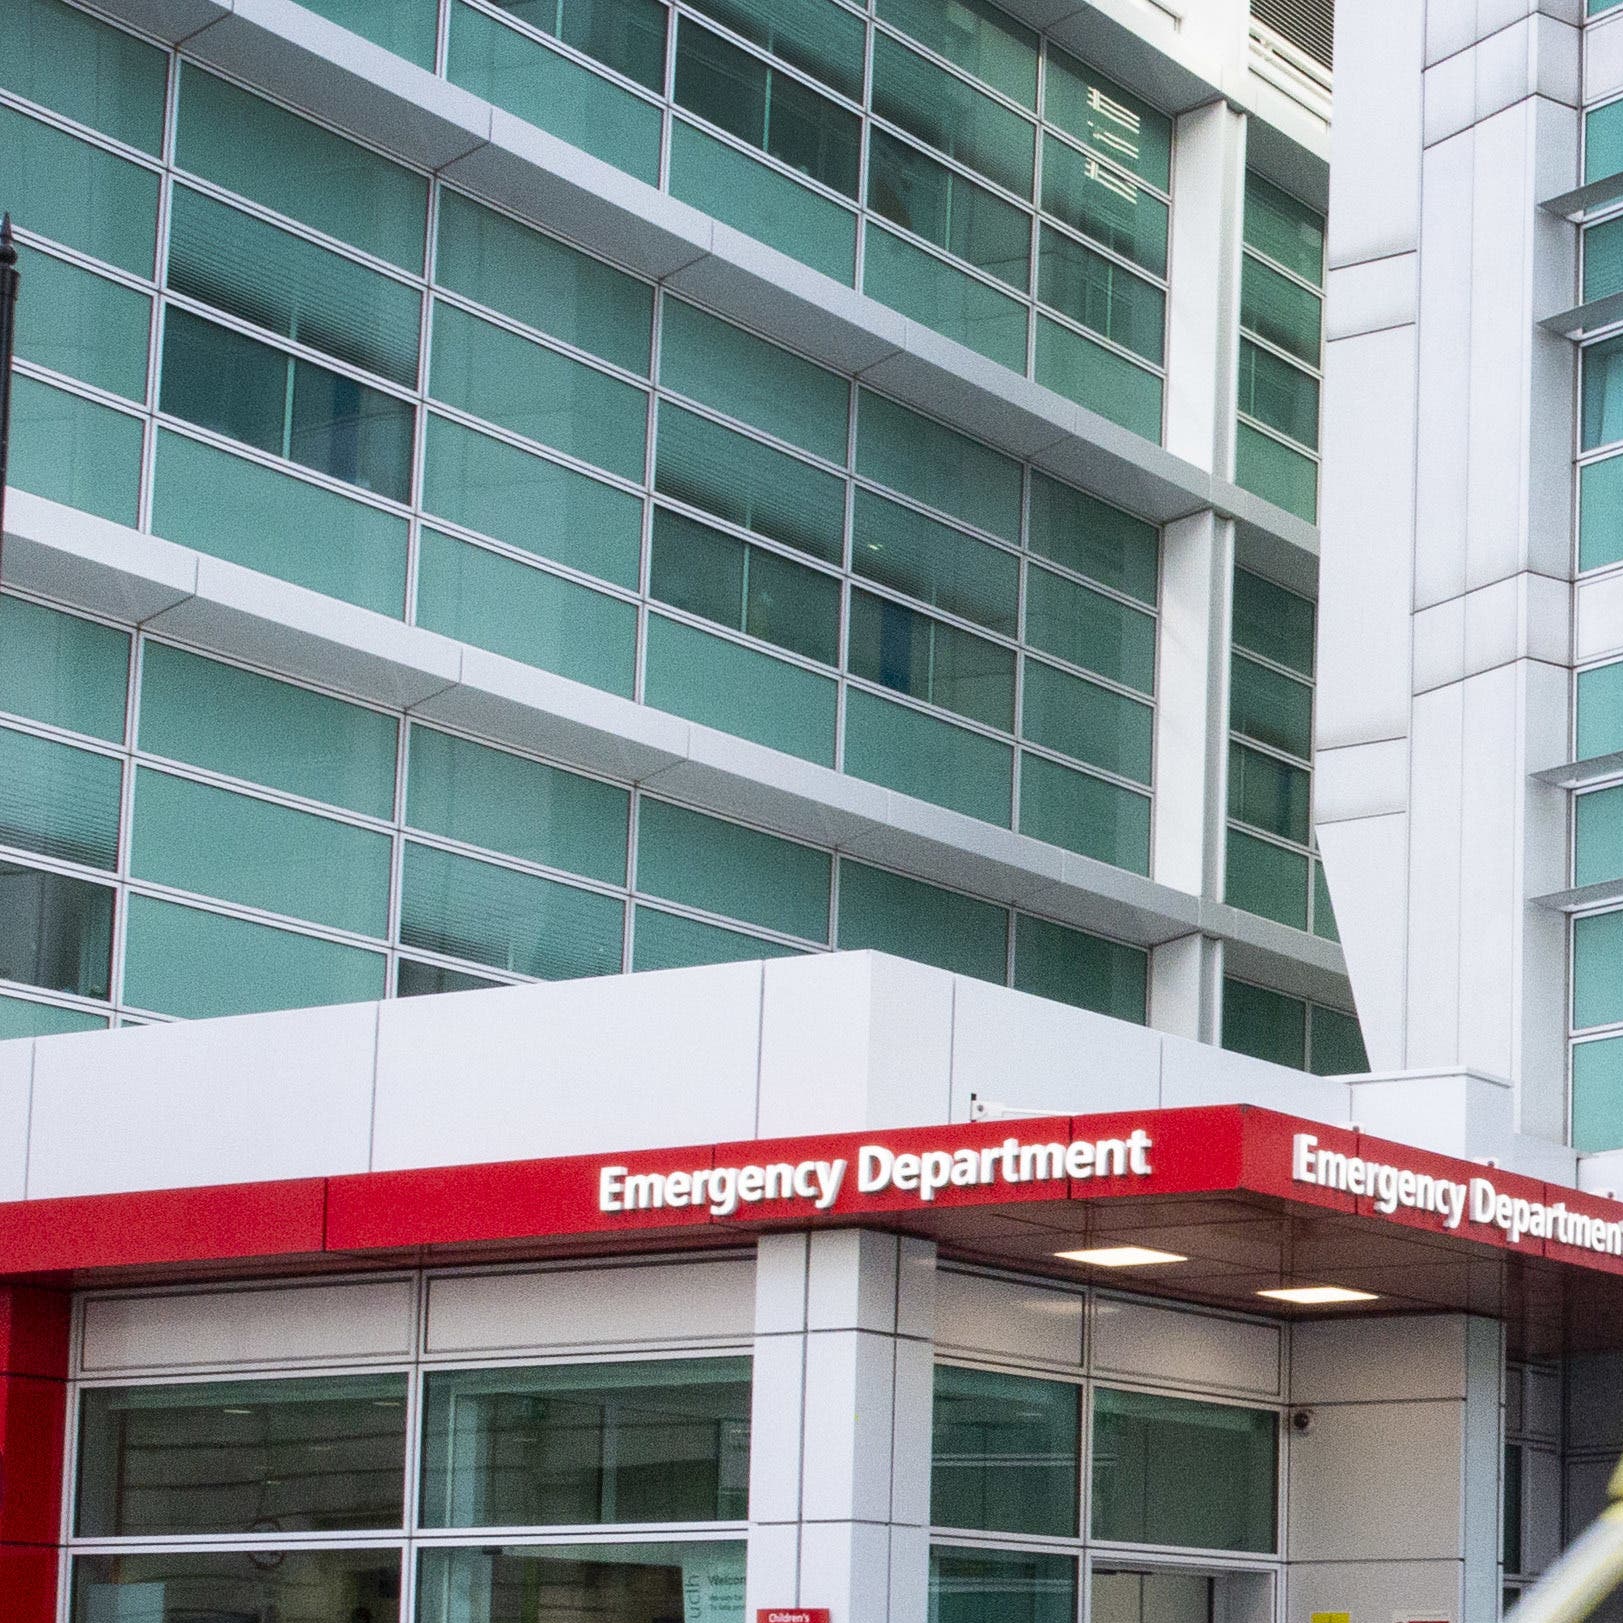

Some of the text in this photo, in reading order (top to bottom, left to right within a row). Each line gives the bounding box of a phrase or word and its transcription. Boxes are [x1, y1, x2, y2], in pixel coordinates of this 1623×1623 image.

[598, 1129, 1153, 1217] Emergency Department
[1292, 1133, 1467, 1229] Emergency
[768, 1613, 810, 1623] Children's
